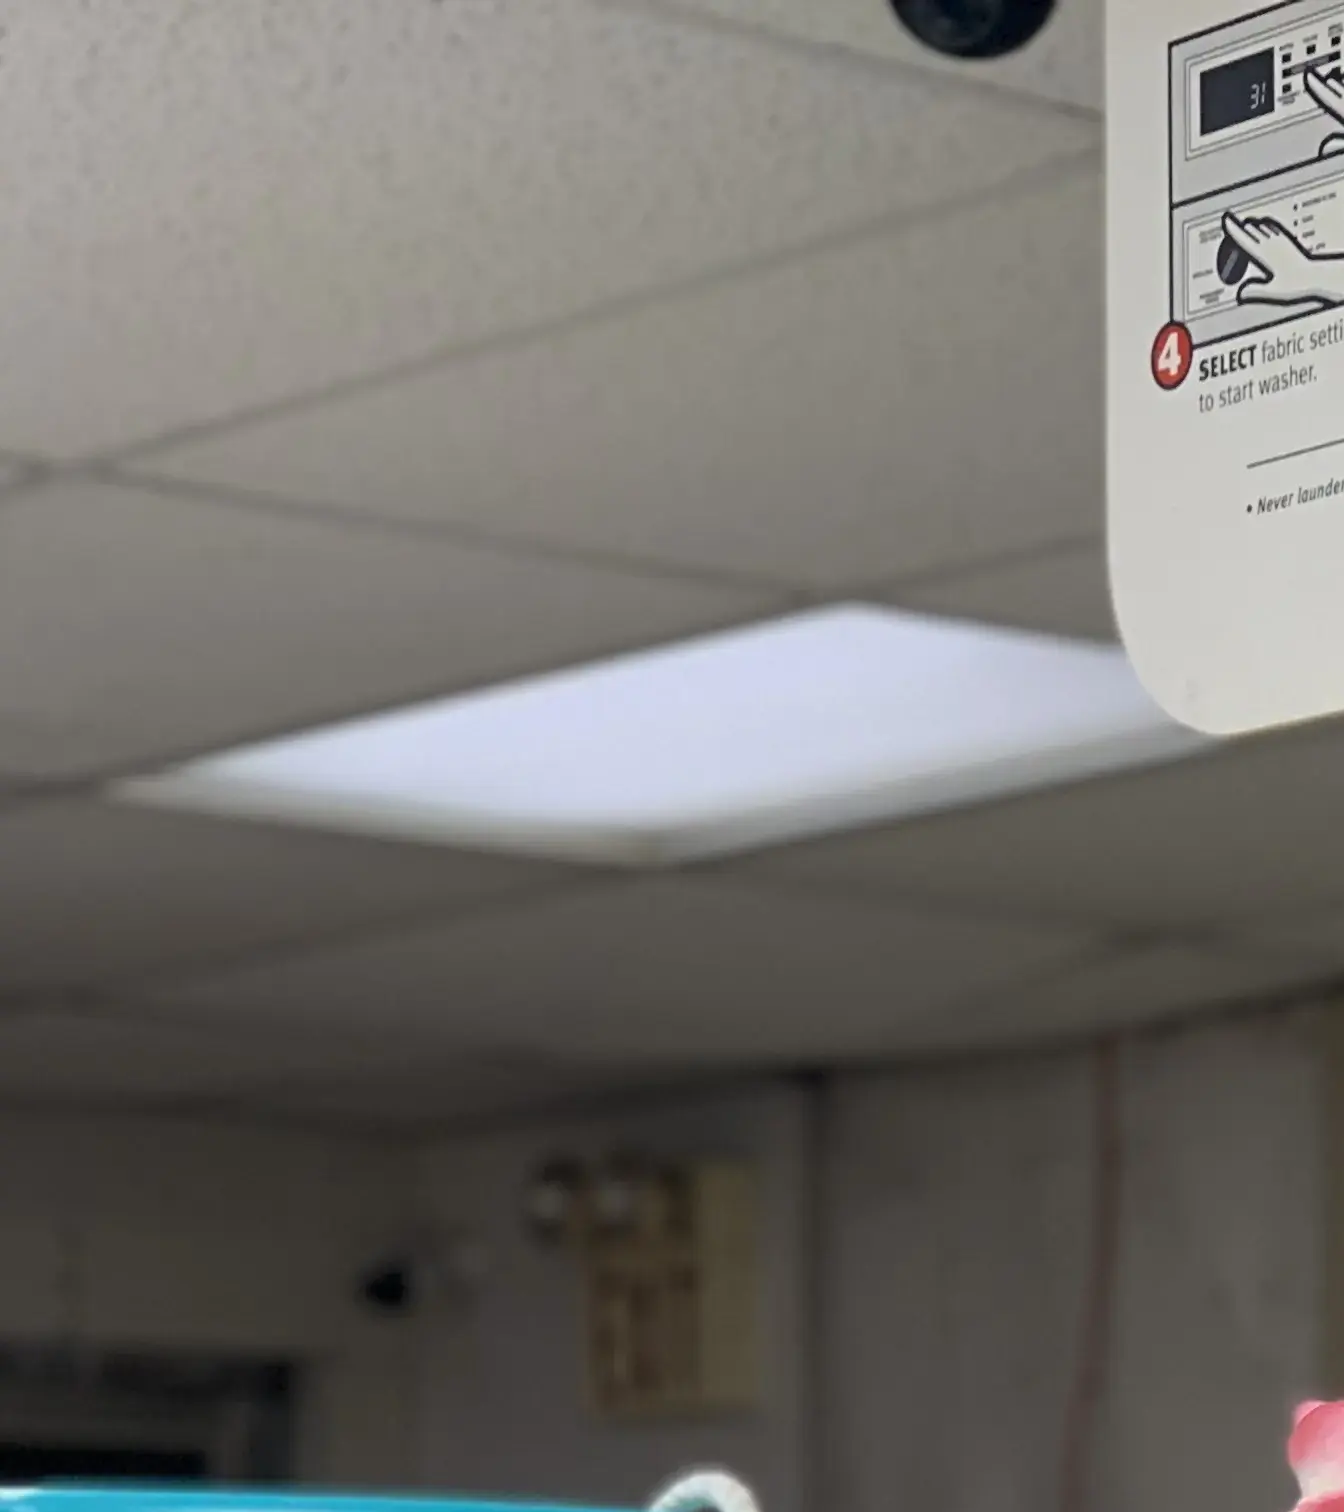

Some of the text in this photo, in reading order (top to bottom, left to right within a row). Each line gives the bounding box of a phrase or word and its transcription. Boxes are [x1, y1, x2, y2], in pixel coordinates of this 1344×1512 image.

[1158, 331, 1182, 375] 4
[1199, 345, 1257, 381] SELECT
[1261, 331, 1304, 364] fabric
[1199, 363, 1317, 413] to start washer.
[1257, 491, 1295, 516] Never
